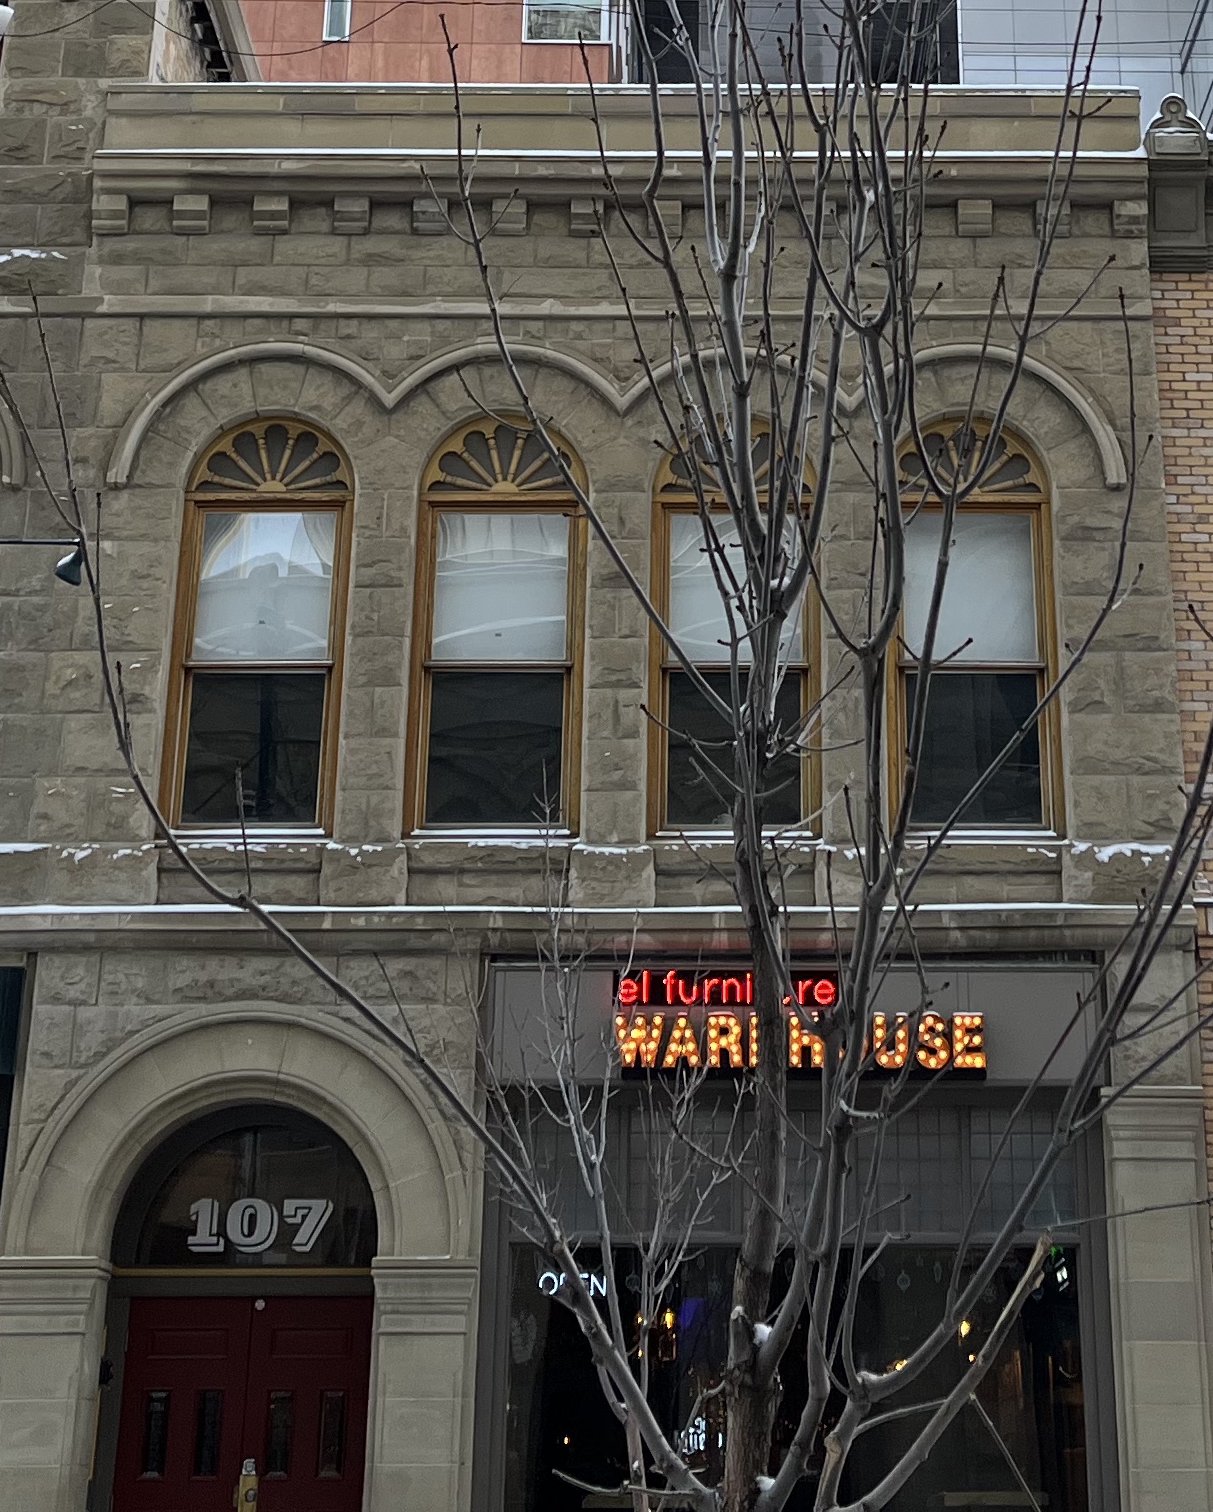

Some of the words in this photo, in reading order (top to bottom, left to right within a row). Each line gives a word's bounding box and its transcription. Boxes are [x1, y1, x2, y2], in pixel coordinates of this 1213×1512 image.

[618, 970, 650, 1004] el
[663, 969, 836, 1005] furnire
[615, 1010, 987, 1069] WARHUSE
[187, 1197, 334, 1253] 107
[538, 1271, 608, 1297] ON
